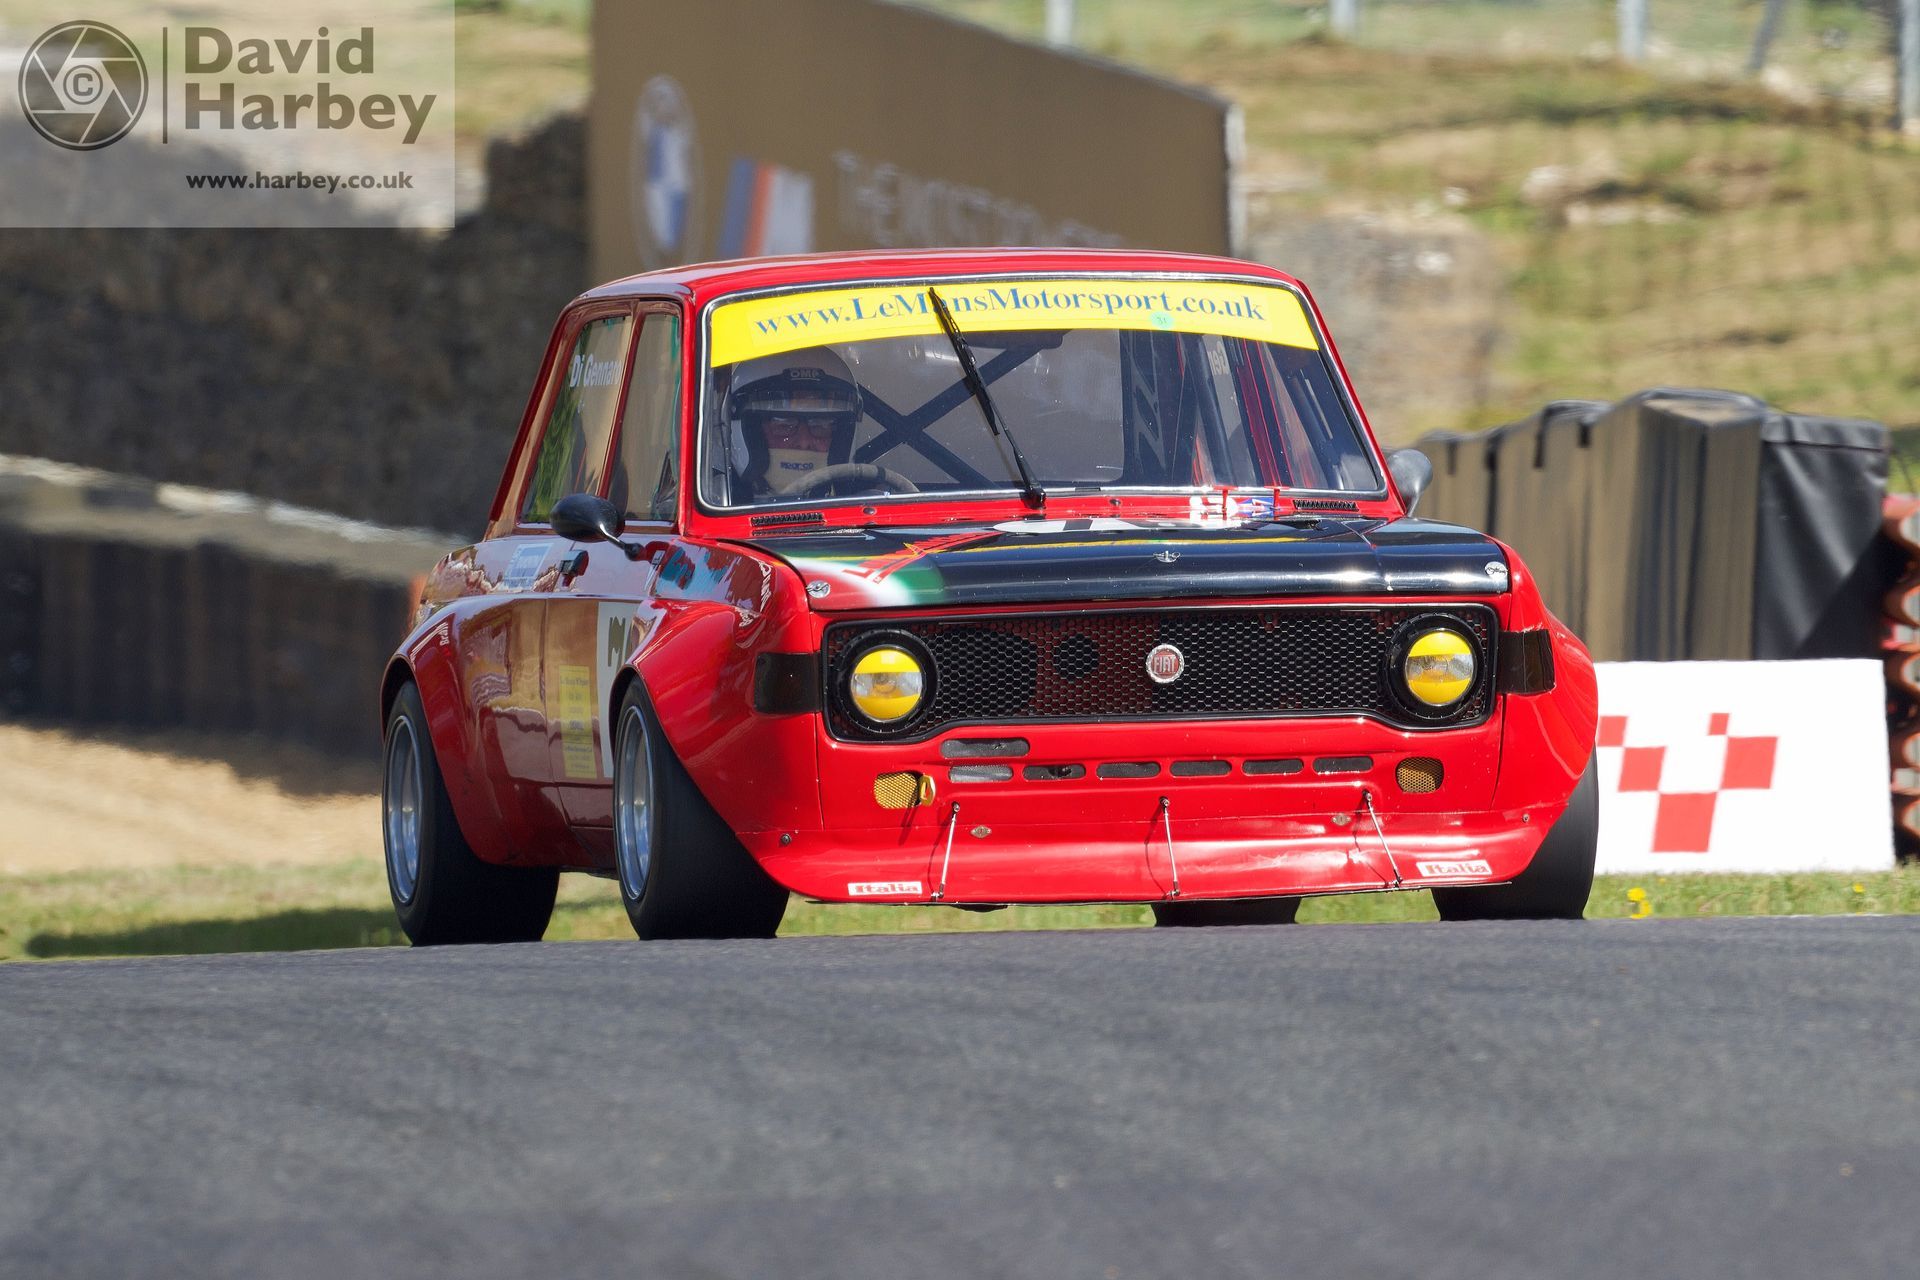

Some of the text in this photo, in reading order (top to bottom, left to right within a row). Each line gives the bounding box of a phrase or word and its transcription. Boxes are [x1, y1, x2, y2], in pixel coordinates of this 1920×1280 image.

[755, 286, 1266, 336] www.LeMnsMotorsport.co.uk
[569, 354, 586, 388] Di
[1154, 655, 1176, 673] FIAT
[1424, 863, 1490, 875] Italia
[855, 883, 919, 894] Italia
